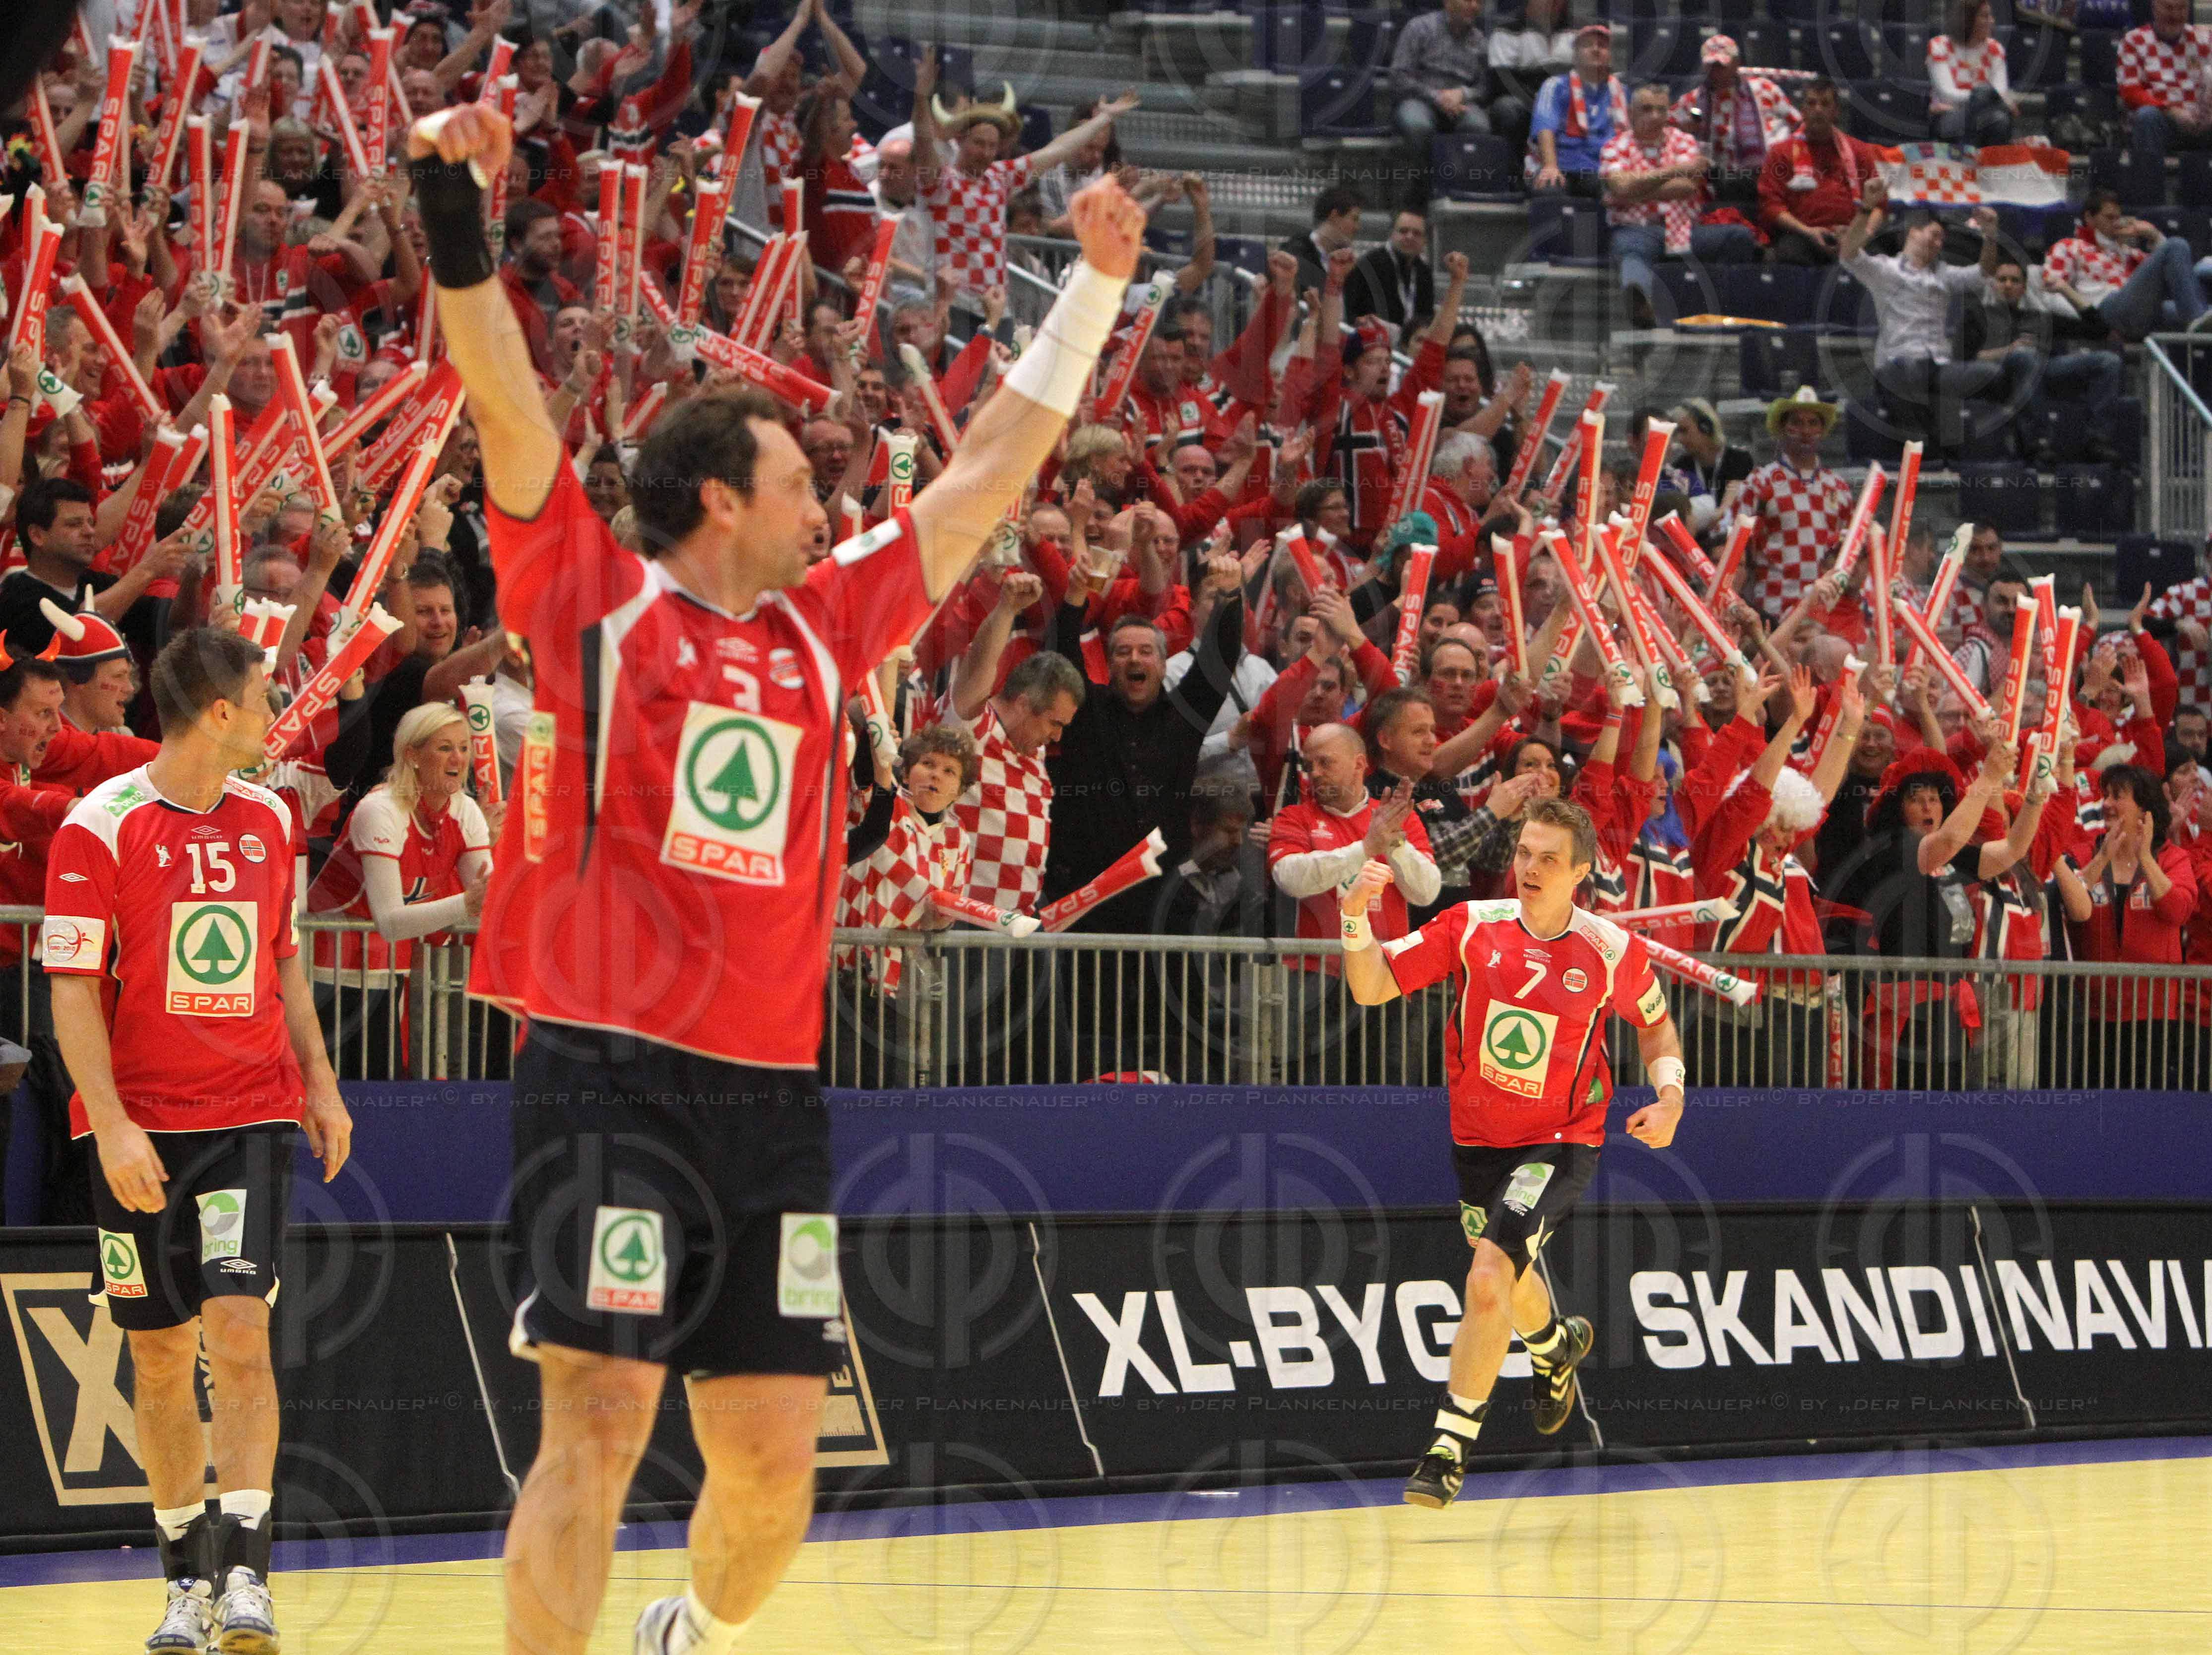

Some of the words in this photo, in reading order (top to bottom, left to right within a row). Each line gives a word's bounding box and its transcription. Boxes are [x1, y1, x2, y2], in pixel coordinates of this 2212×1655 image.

[90, 98, 120, 182] SPAR
[1621, 481, 1651, 565] SPAR
[1577, 582, 1622, 662] SPAR
[722, 663, 761, 713] 3
[2041, 668, 2062, 752] SPAR
[265, 671, 341, 757] SPAR
[474, 737, 493, 786] AR
[1803, 714, 1832, 768] SPA
[186, 842, 236, 893] 15
[671, 836, 774, 879] SPAR
[1041, 884, 1099, 920] SPA
[1580, 925, 1608, 953] SPAR
[1645, 942, 1716, 980] SPAR
[172, 995, 249, 1012] SPAR
[1514, 960, 1547, 999] 7
[1483, 1066, 1539, 1094] SPAR
[106, 1282, 143, 1294] SPAR
[1629, 1259, 2212, 1369] SKANDINAVI
